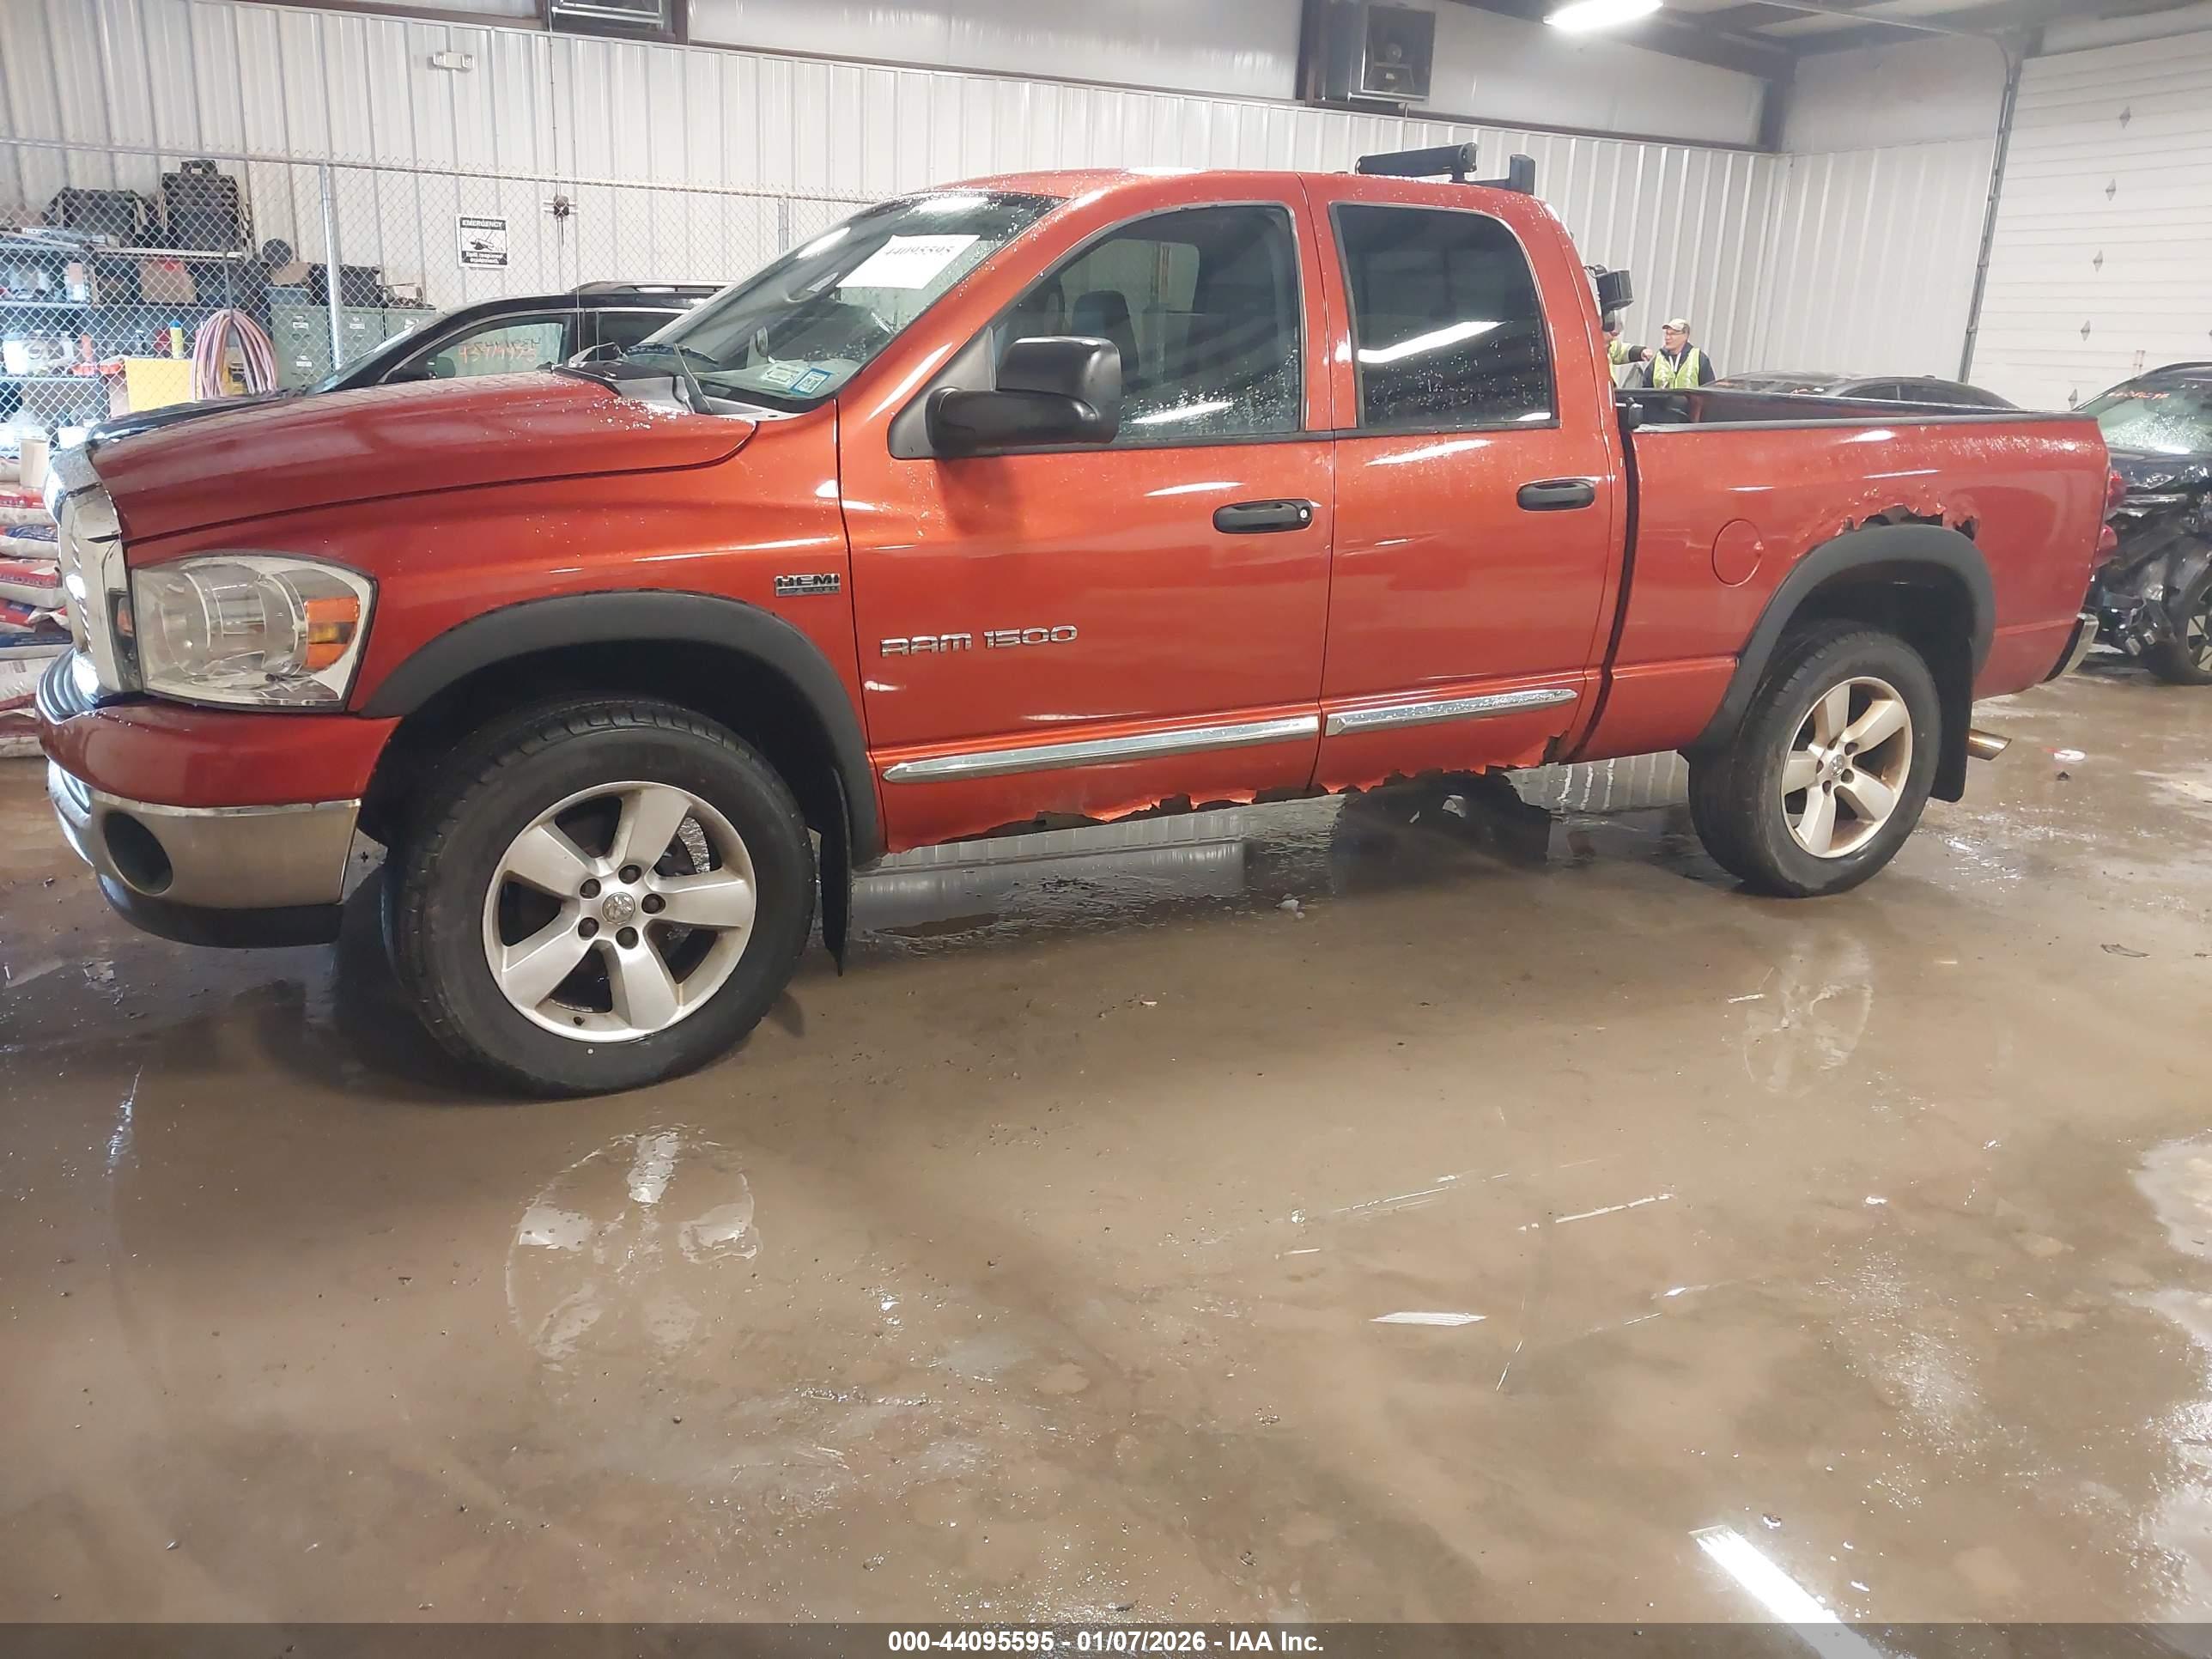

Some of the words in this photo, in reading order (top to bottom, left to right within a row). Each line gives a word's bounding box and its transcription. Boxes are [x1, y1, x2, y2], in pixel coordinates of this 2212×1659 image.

[462, 219, 502, 228] EMERGENCY
[776, 574, 841, 587] HEMI
[881, 633, 972, 659] RAM
[983, 625, 1079, 650] 1500
